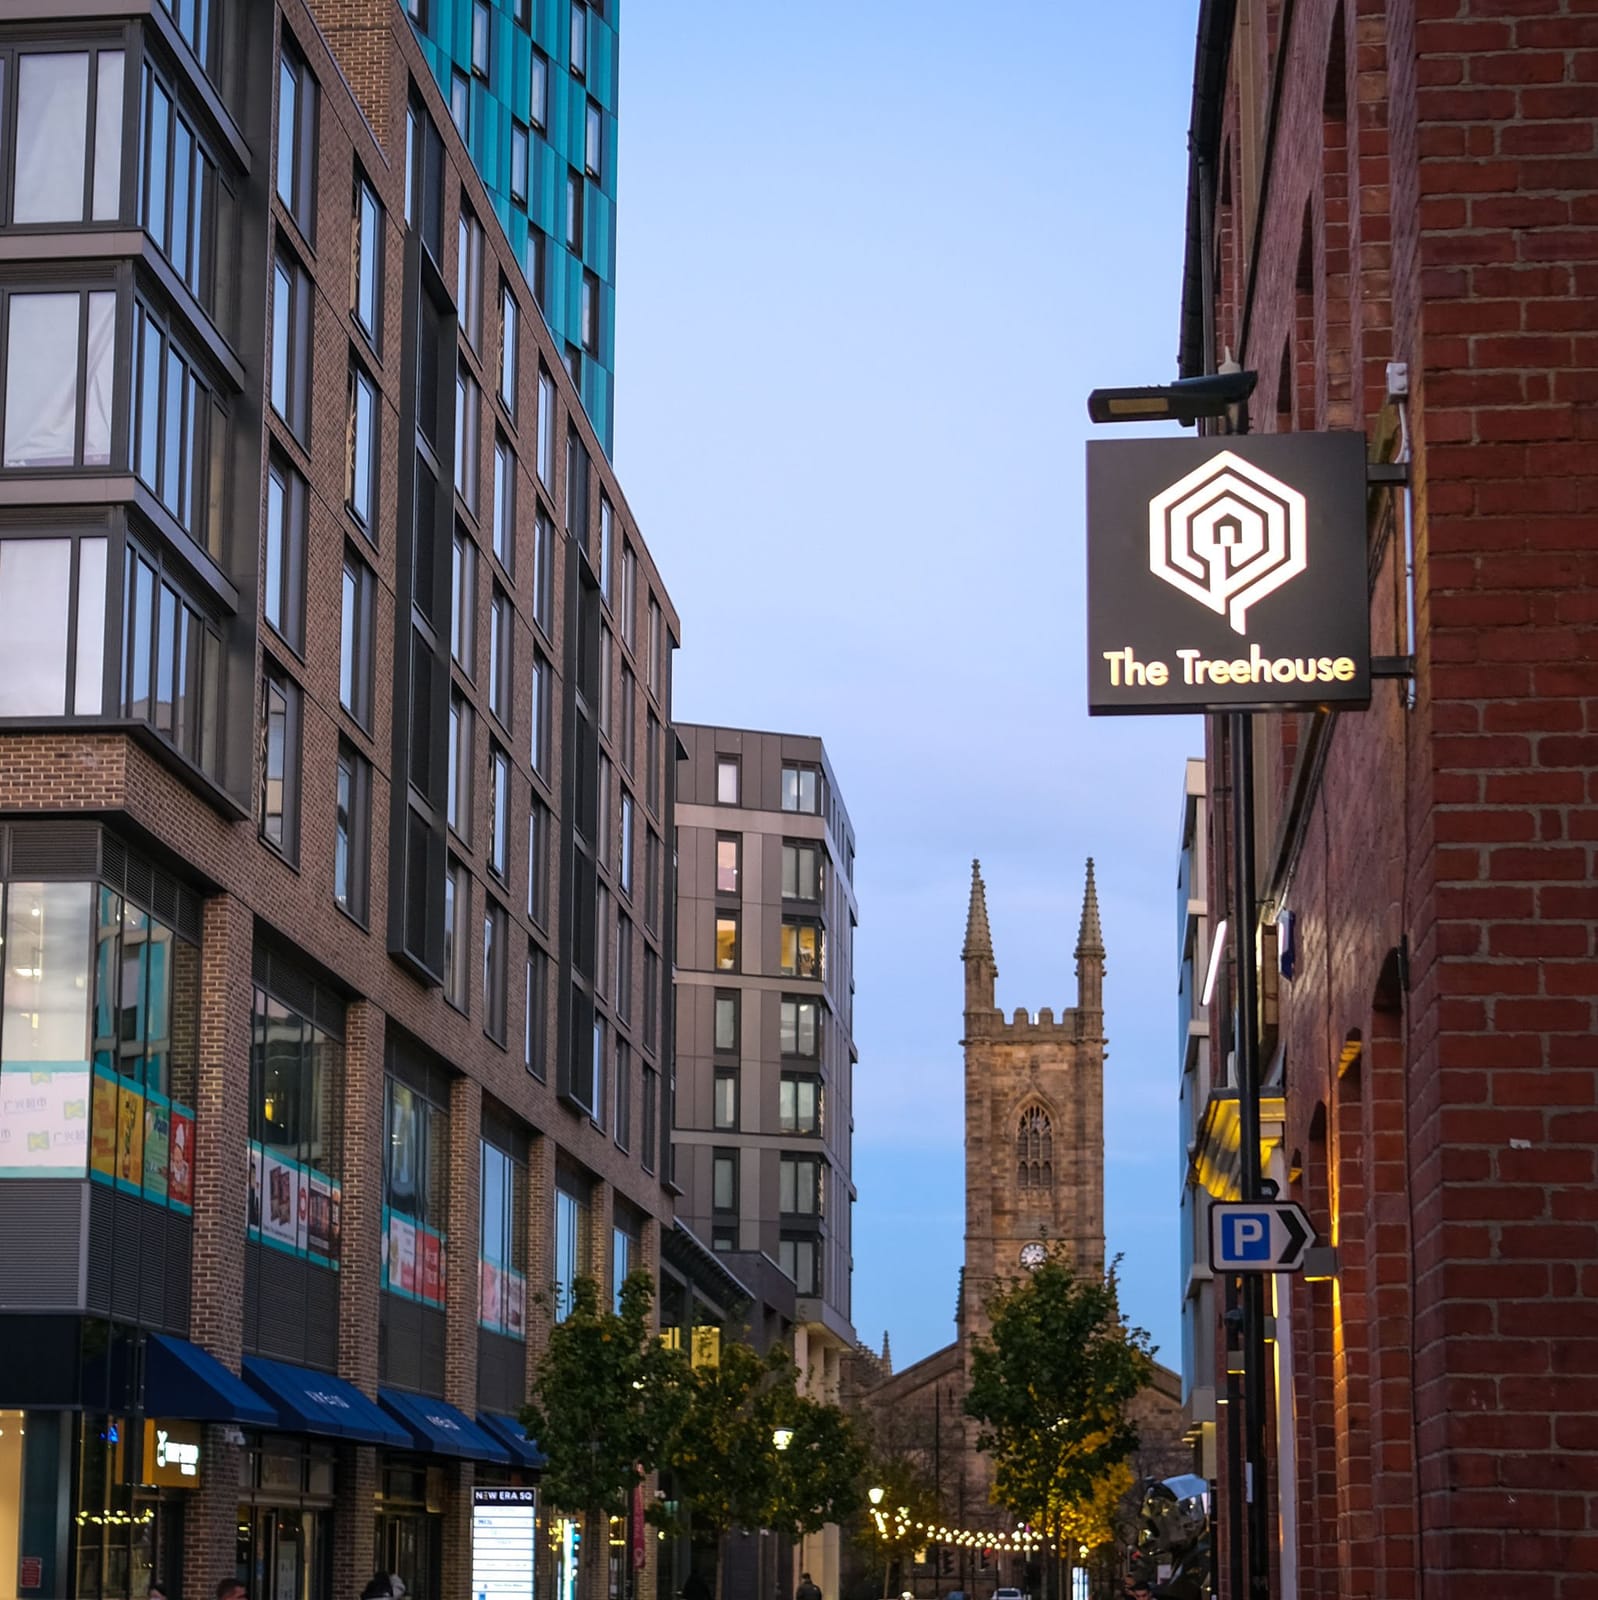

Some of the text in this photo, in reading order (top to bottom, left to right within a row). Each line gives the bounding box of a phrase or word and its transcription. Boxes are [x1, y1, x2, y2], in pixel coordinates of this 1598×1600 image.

[1103, 644, 1356, 686] The Treehouse
[1234, 1219, 1263, 1256] P
[475, 1491, 533, 1500] NEW ERA SQ
